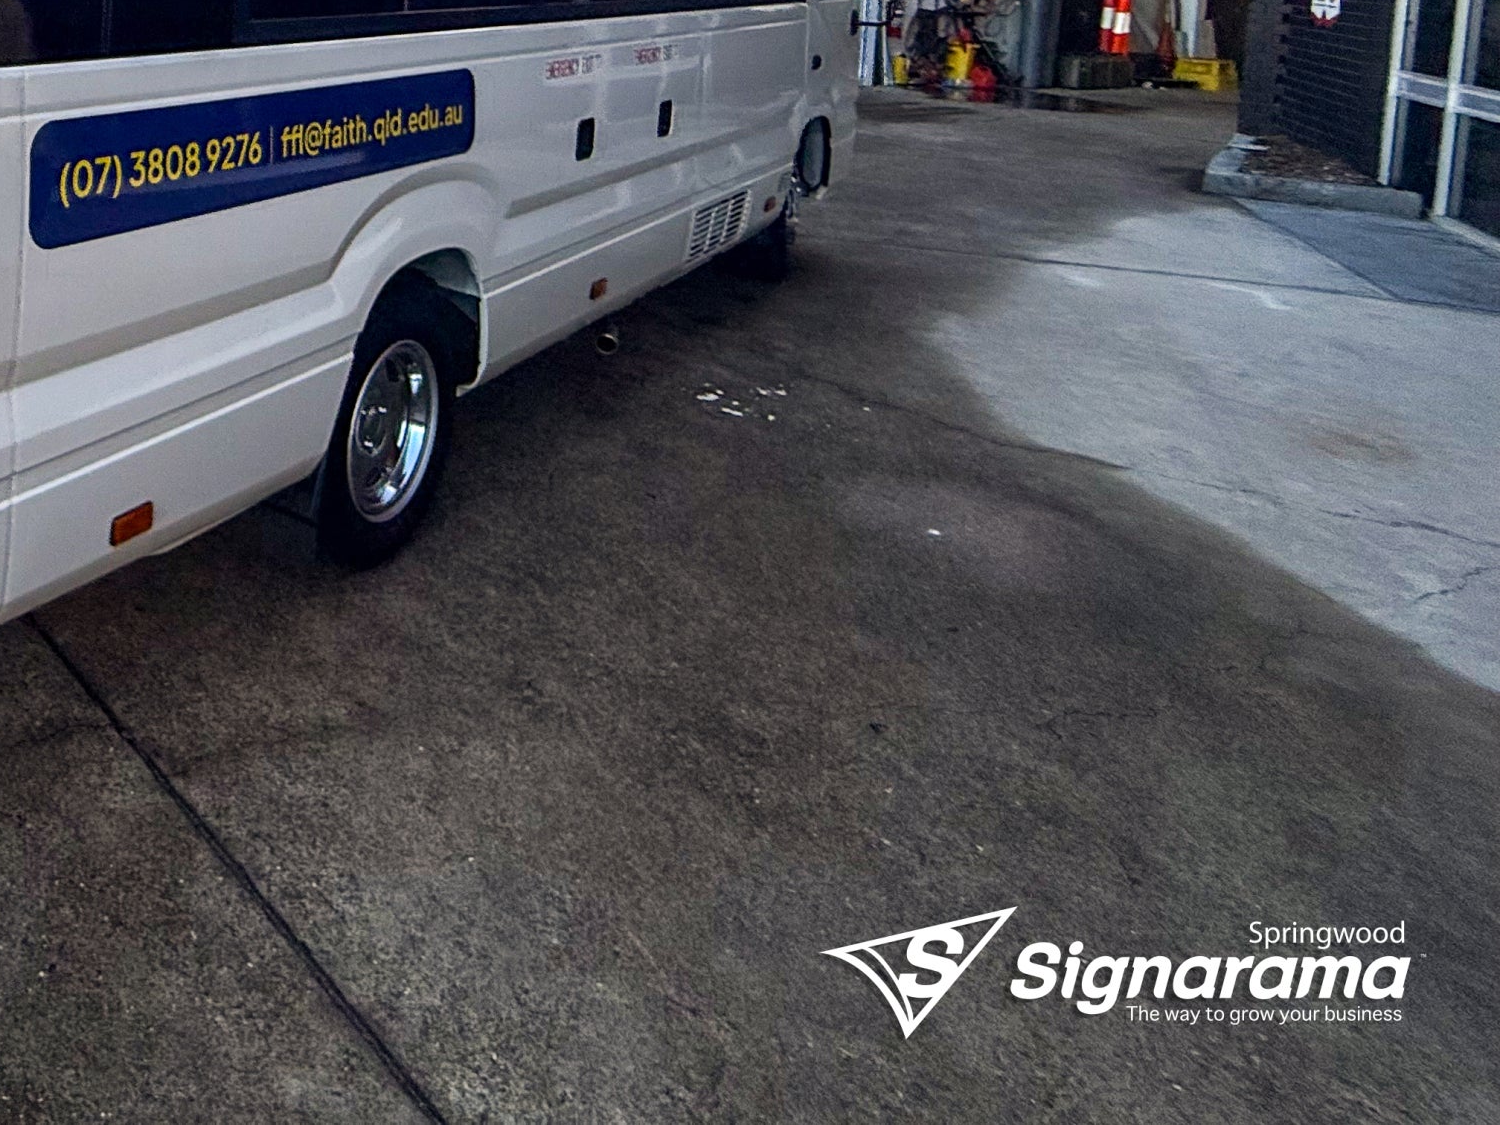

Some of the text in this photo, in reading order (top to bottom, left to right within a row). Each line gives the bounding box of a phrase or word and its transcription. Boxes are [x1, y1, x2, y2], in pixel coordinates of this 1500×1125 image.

[59, 102, 464, 209] (07) 3808 9276 ffl@faith.qld.edu.au
